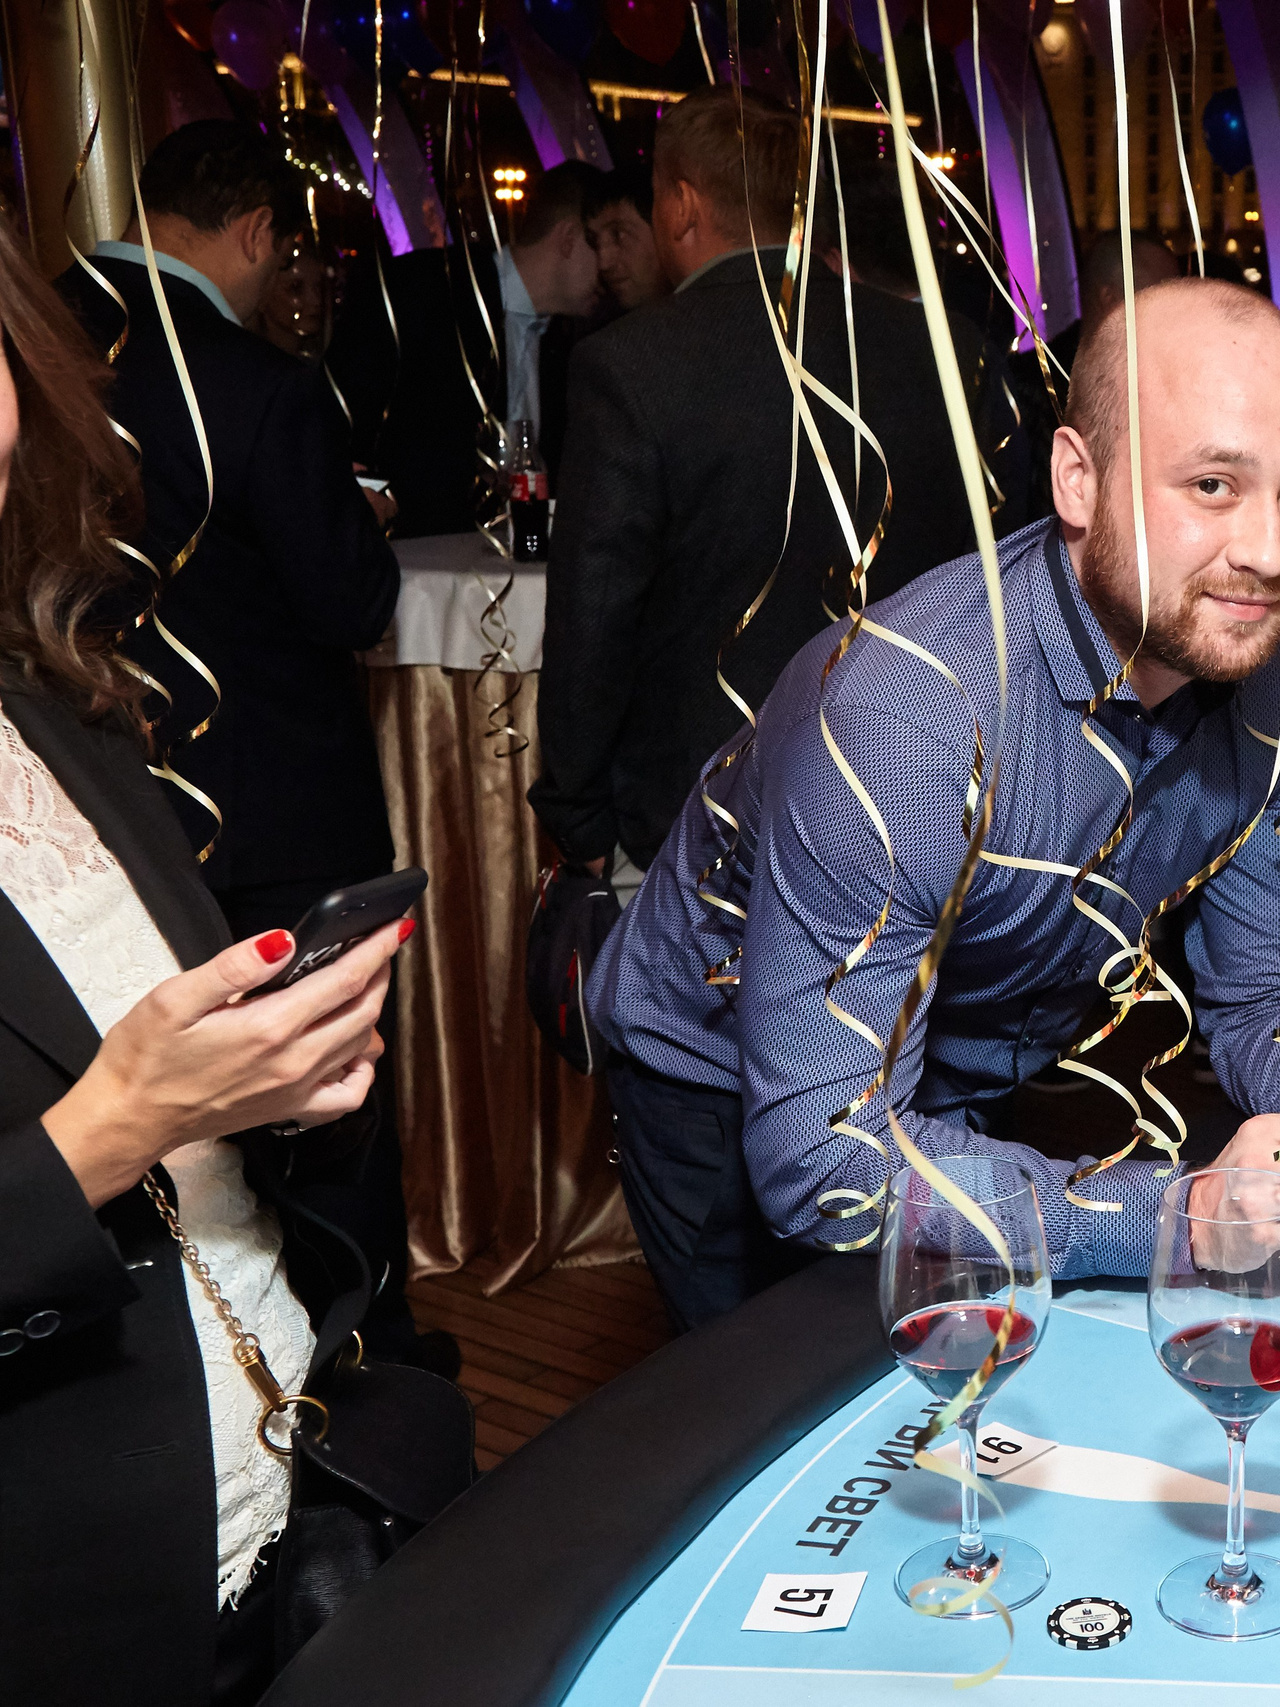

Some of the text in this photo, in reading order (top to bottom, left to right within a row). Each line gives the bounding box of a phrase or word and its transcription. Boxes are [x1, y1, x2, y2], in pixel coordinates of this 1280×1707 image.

[796, 1476, 892, 1557] СВЕТ
[773, 1588, 834, 1618] 57
[1079, 1621, 1105, 1633] 100
